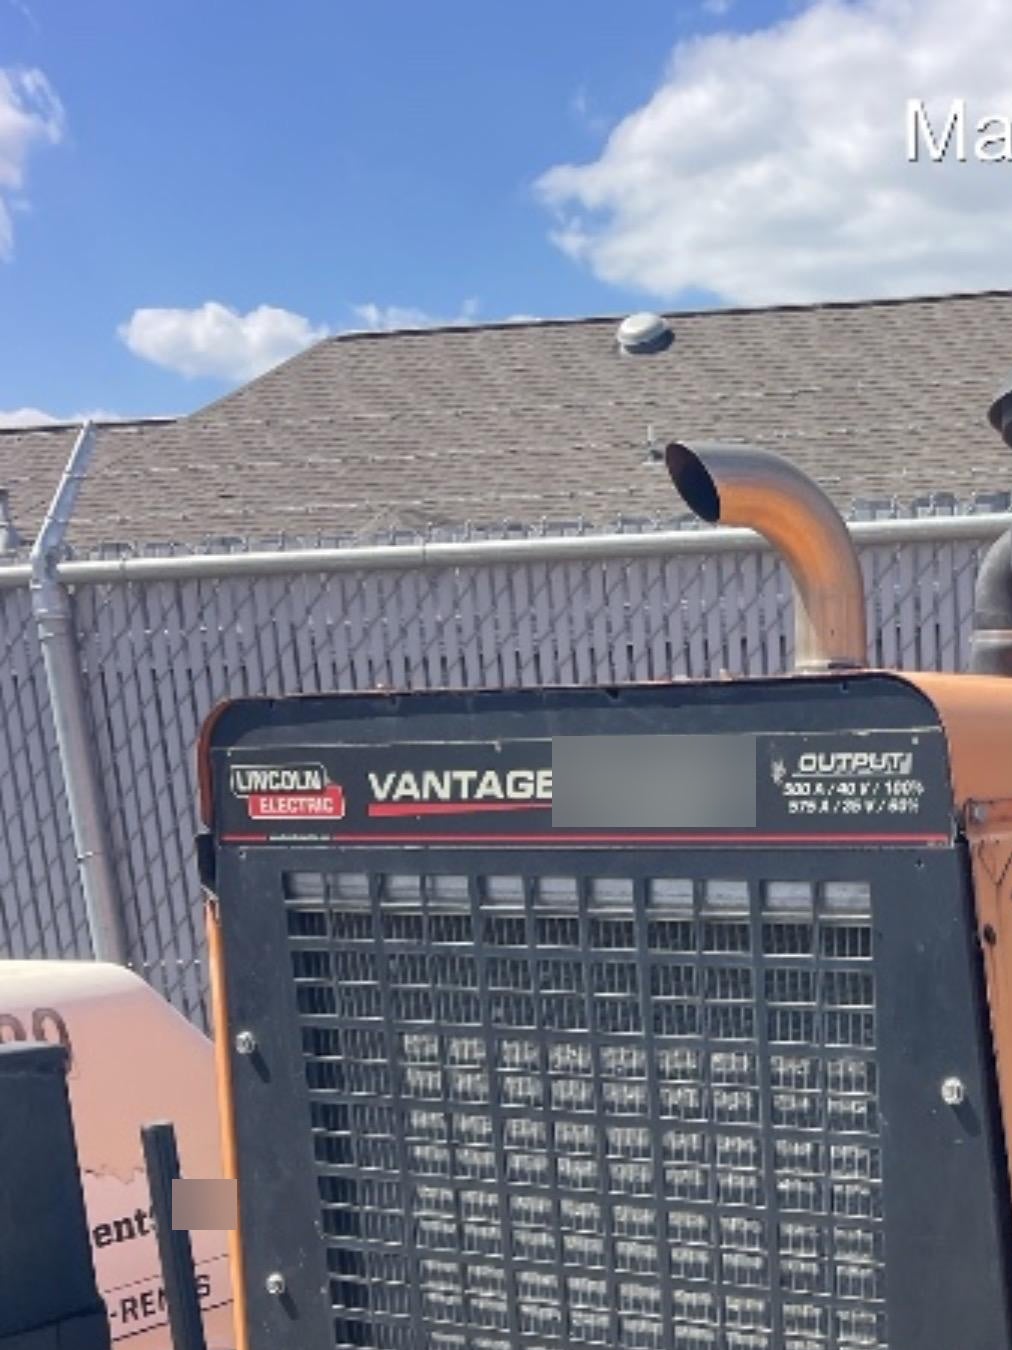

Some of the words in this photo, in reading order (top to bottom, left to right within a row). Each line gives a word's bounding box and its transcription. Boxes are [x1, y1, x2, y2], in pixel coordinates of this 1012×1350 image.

[798, 752, 906, 773] OUTPUT
[235, 770, 322, 792] LINCOLN
[367, 769, 553, 801] VANTAGE
[259, 796, 334, 815] ELECTRIC
